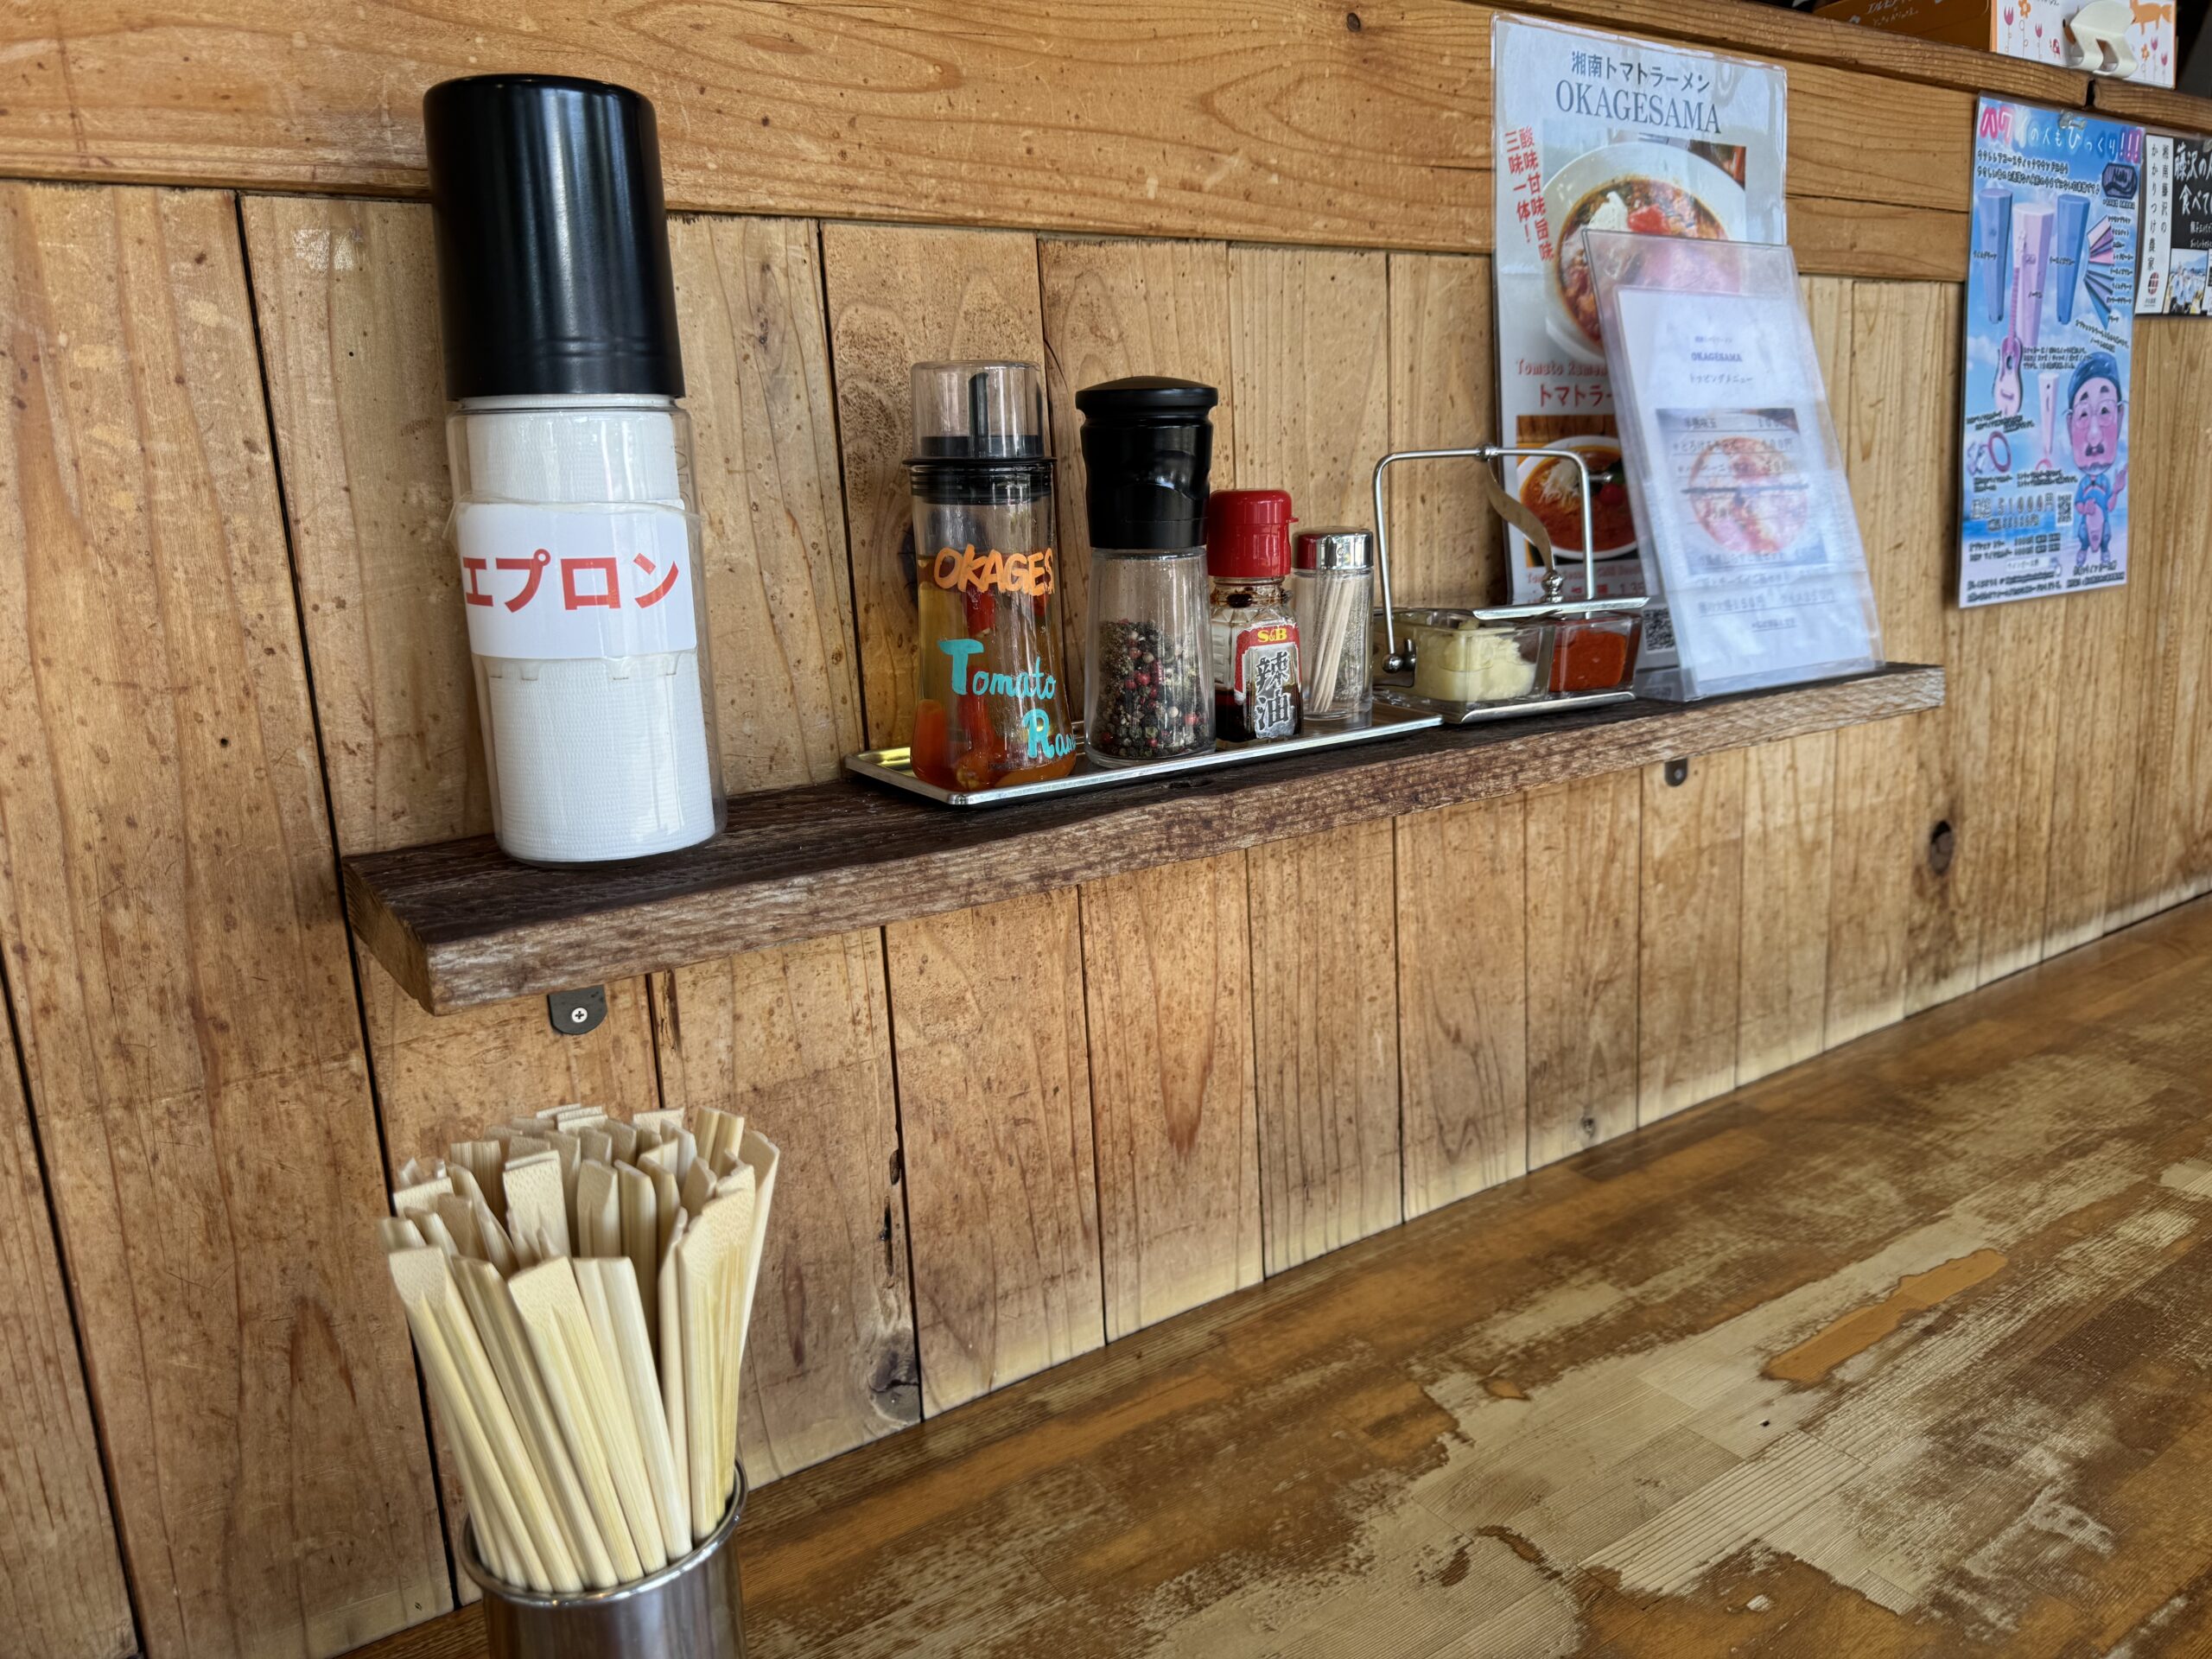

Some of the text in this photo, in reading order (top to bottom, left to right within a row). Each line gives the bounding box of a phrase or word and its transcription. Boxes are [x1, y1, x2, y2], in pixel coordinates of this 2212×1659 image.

[1572, 51, 1710, 93] 湘南トマトラーメン
[1556, 80, 1721, 134] OKAGESAMA
[1519, 126, 1554, 261] 酸味甘味旨味
[1516, 359, 1564, 376] Tomato
[1691, 352, 1743, 362] OKAGESAMA
[462, 548, 679, 613] エプロン
[933, 543, 1055, 596] OKAGES
[1257, 627, 1287, 643] S&B
[937, 638, 1057, 700] Tomato
[1256, 652, 1288, 731] 辣油
